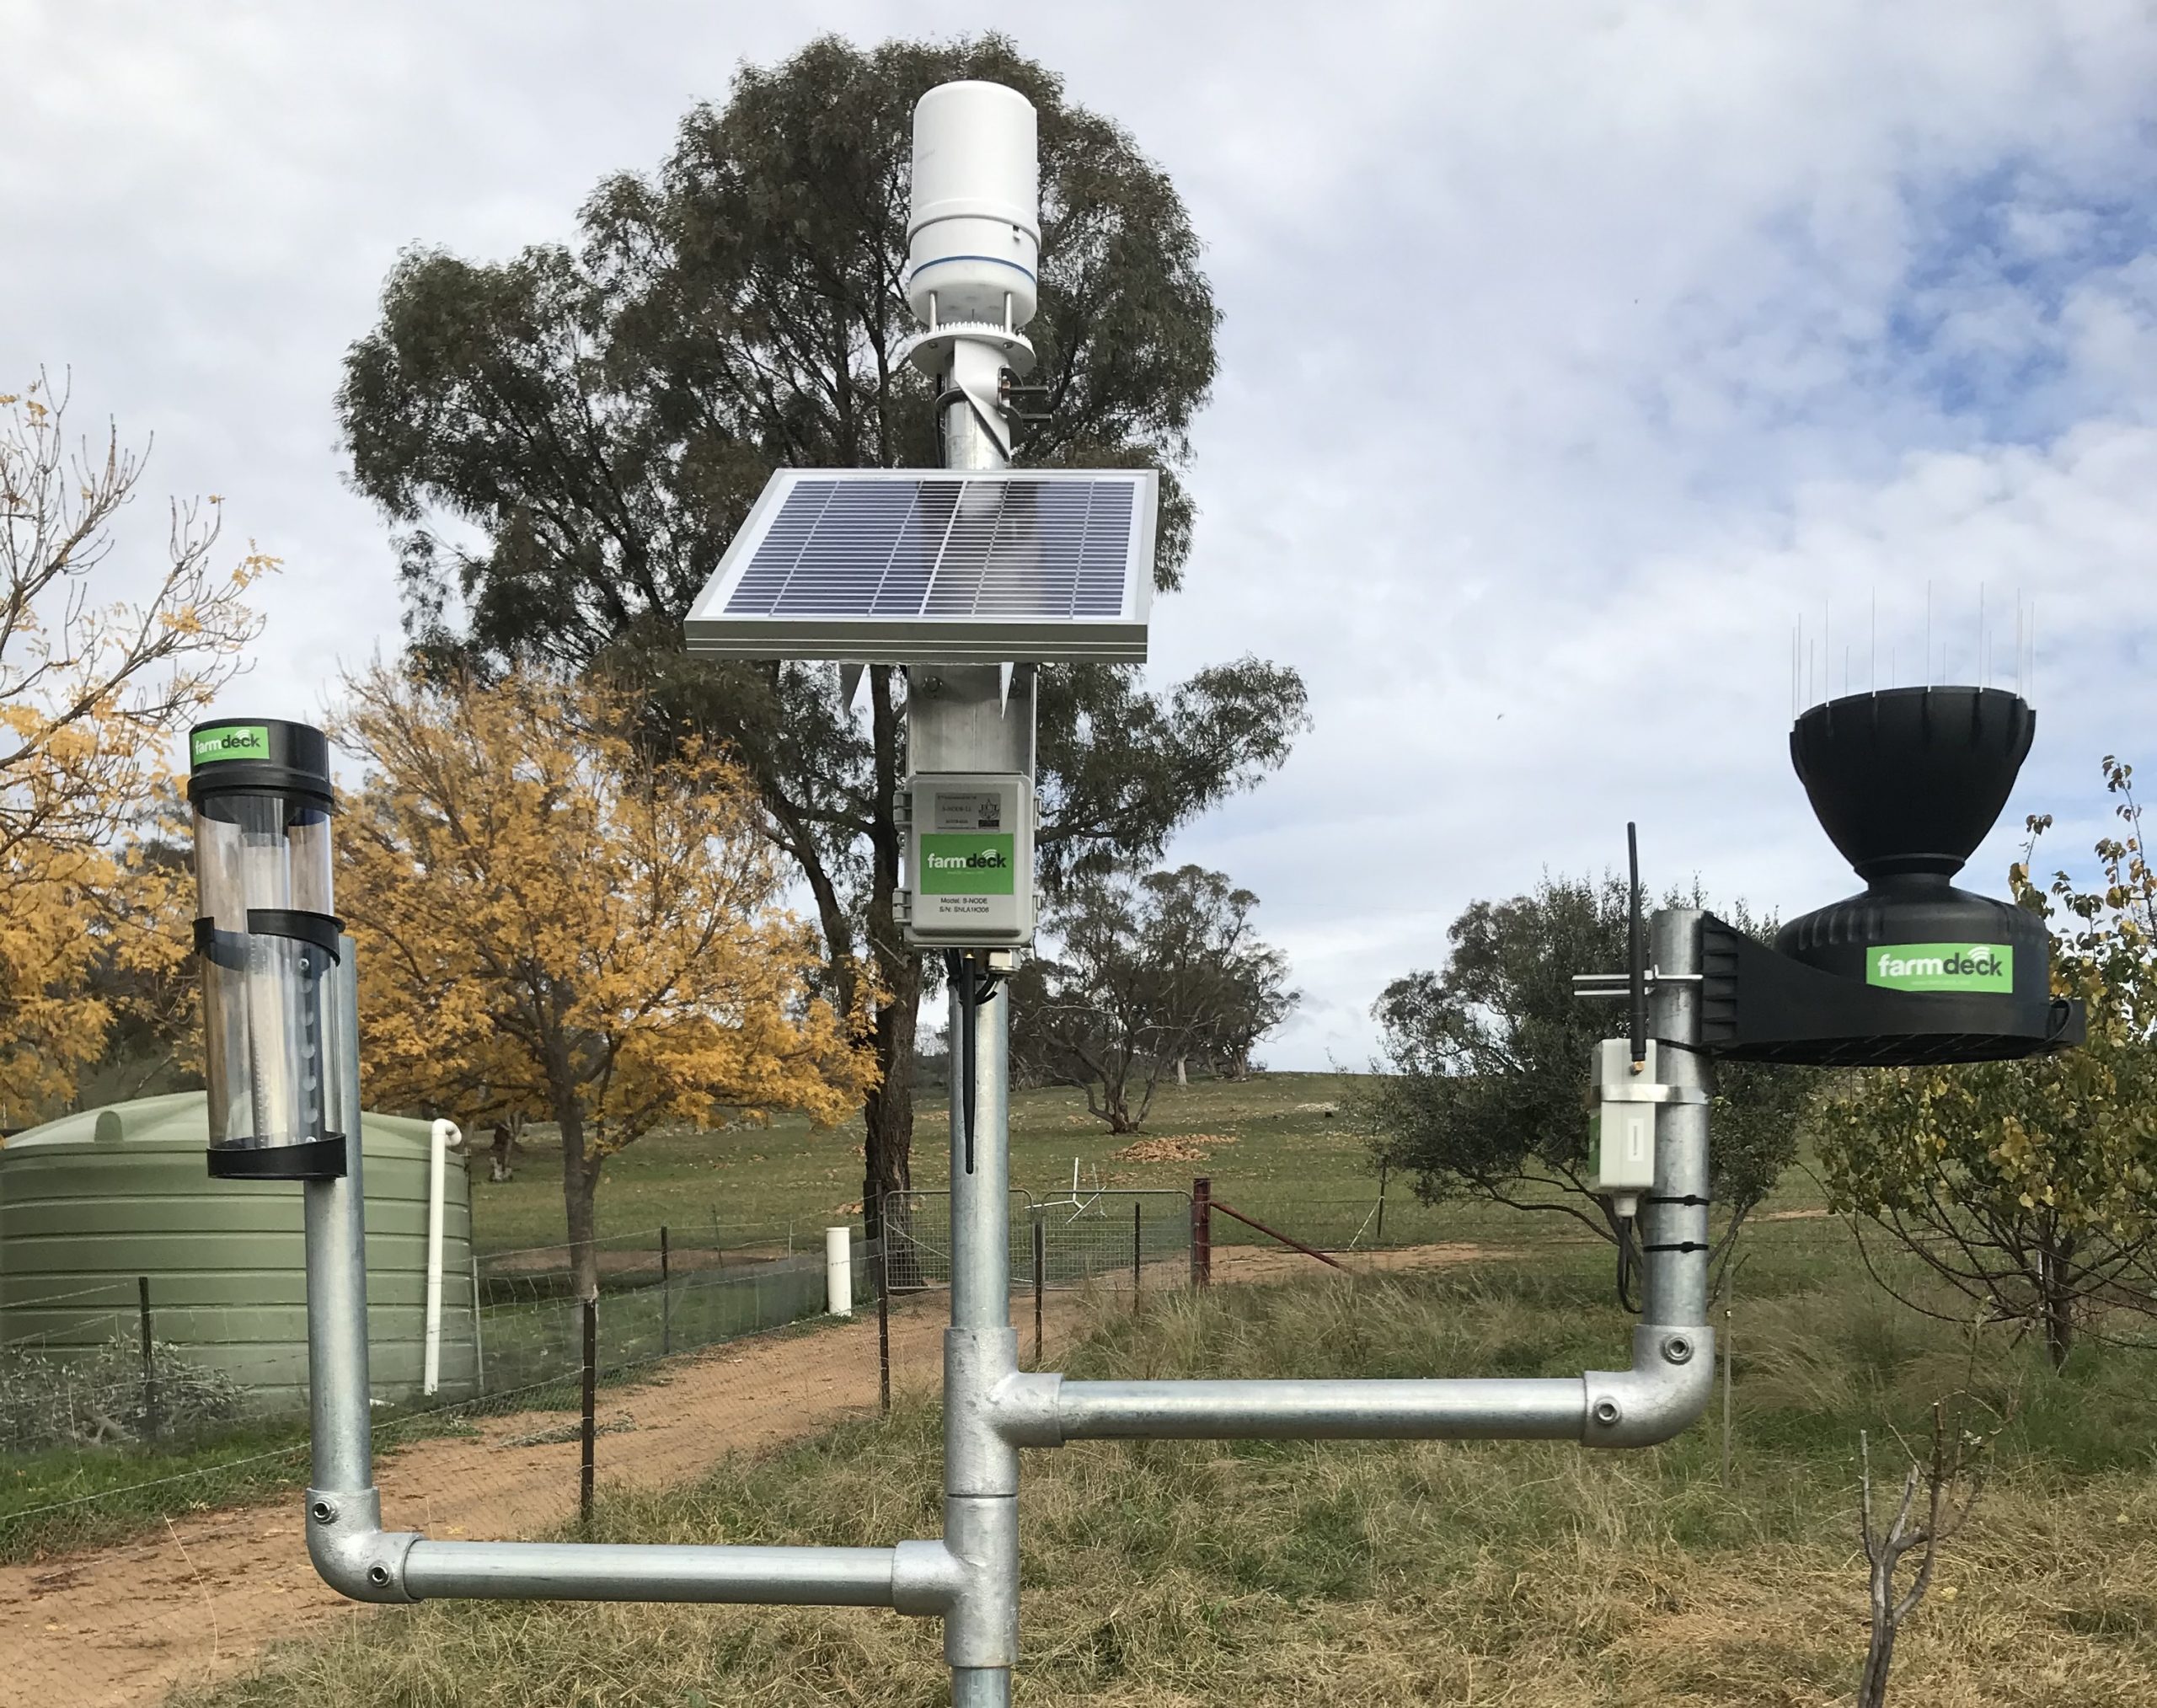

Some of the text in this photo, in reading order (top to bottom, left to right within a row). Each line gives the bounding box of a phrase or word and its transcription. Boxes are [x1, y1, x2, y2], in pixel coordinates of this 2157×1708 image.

[195, 733, 261, 755] farmdeck
[928, 853, 1006, 869] farmdeck
[1877, 952, 2004, 977] farmdeck
